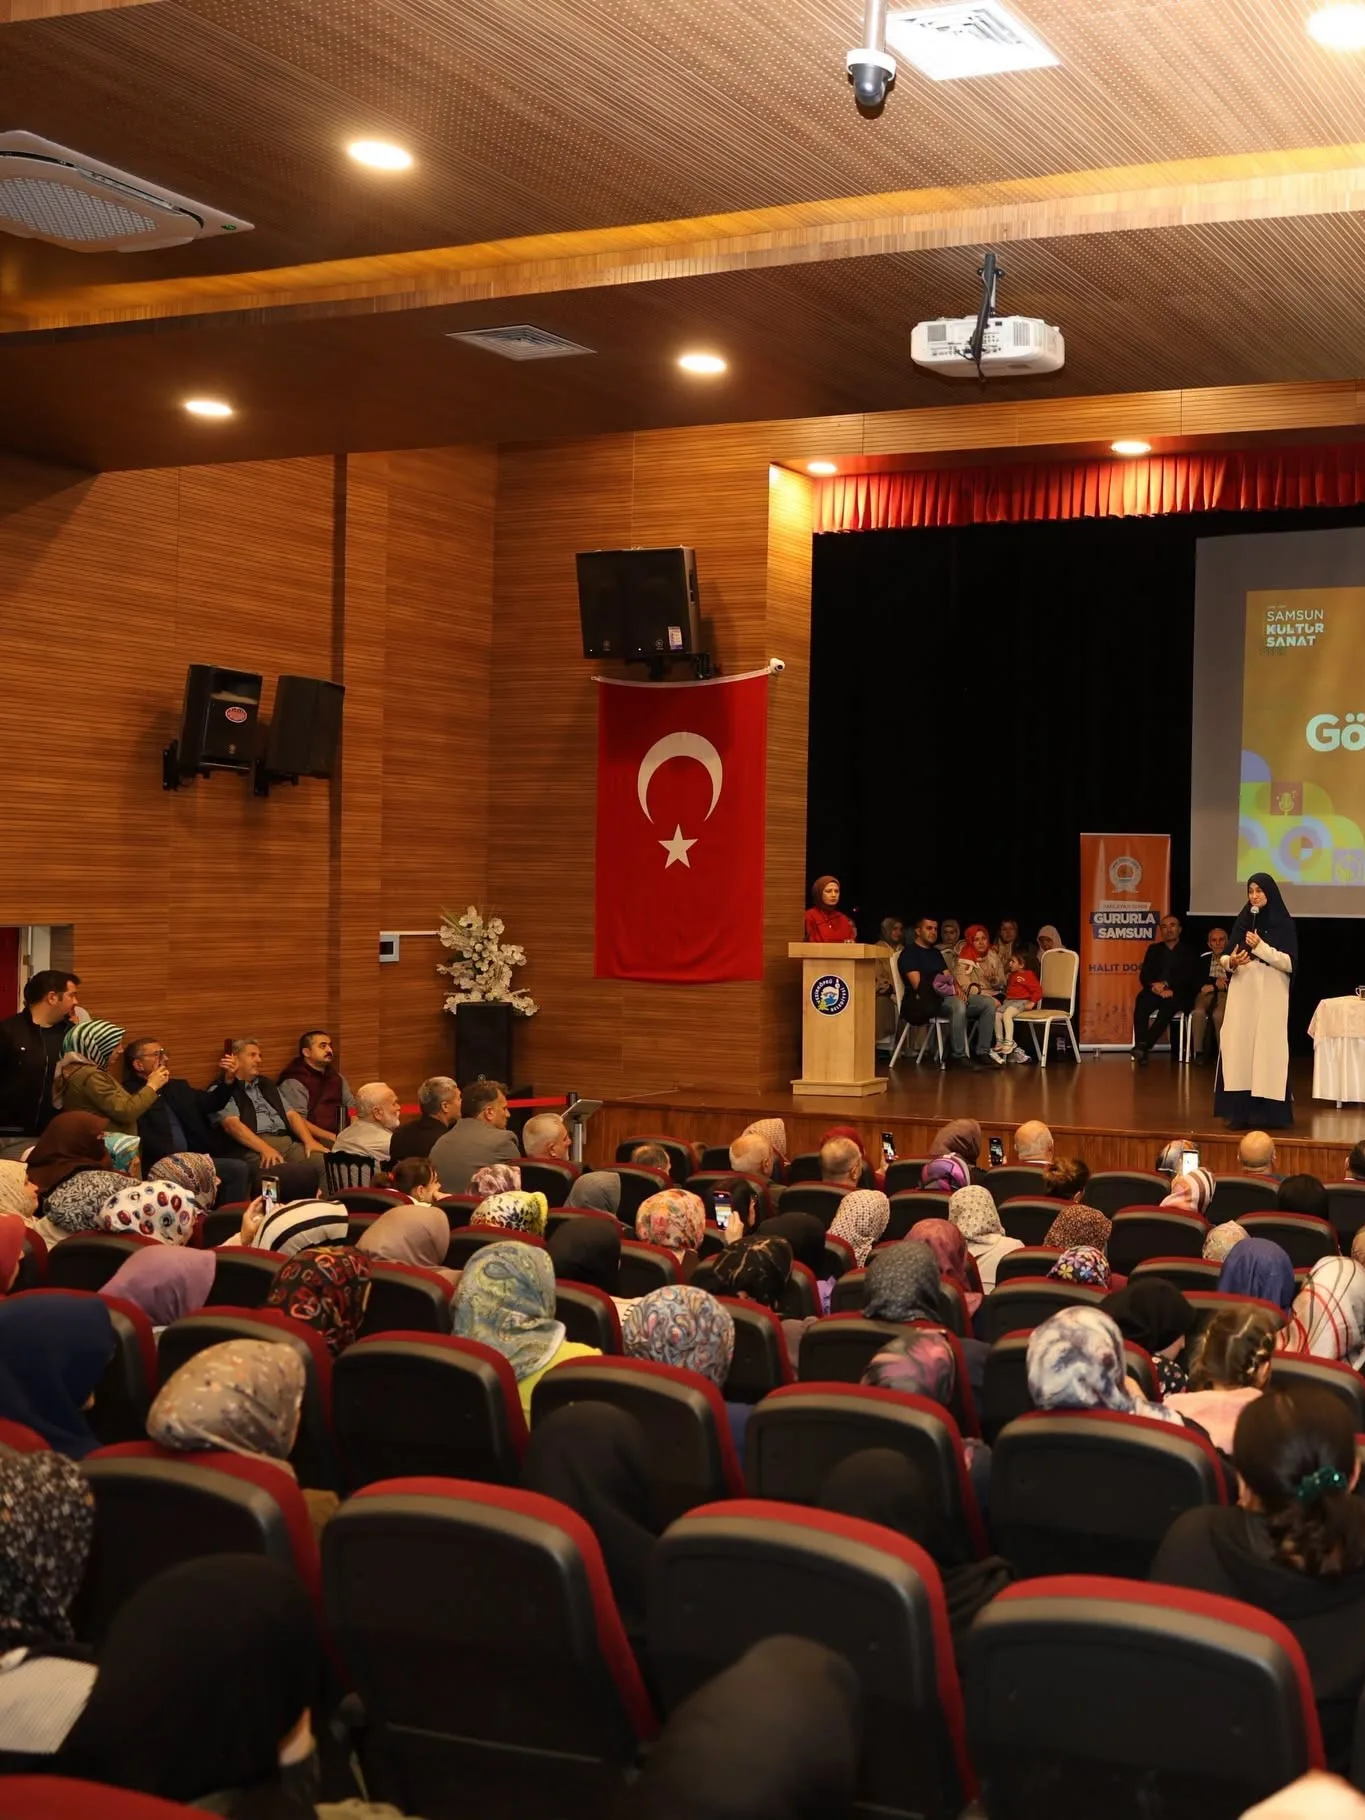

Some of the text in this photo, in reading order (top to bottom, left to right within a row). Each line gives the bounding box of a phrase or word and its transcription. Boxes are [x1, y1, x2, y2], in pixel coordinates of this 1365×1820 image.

[1266, 609, 1324, 622] SAMSUN
[1266, 636, 1316, 648] SANAT
[1094, 913, 1156, 924] GURURLA
[1098, 927, 1153, 939] SAMSUN
